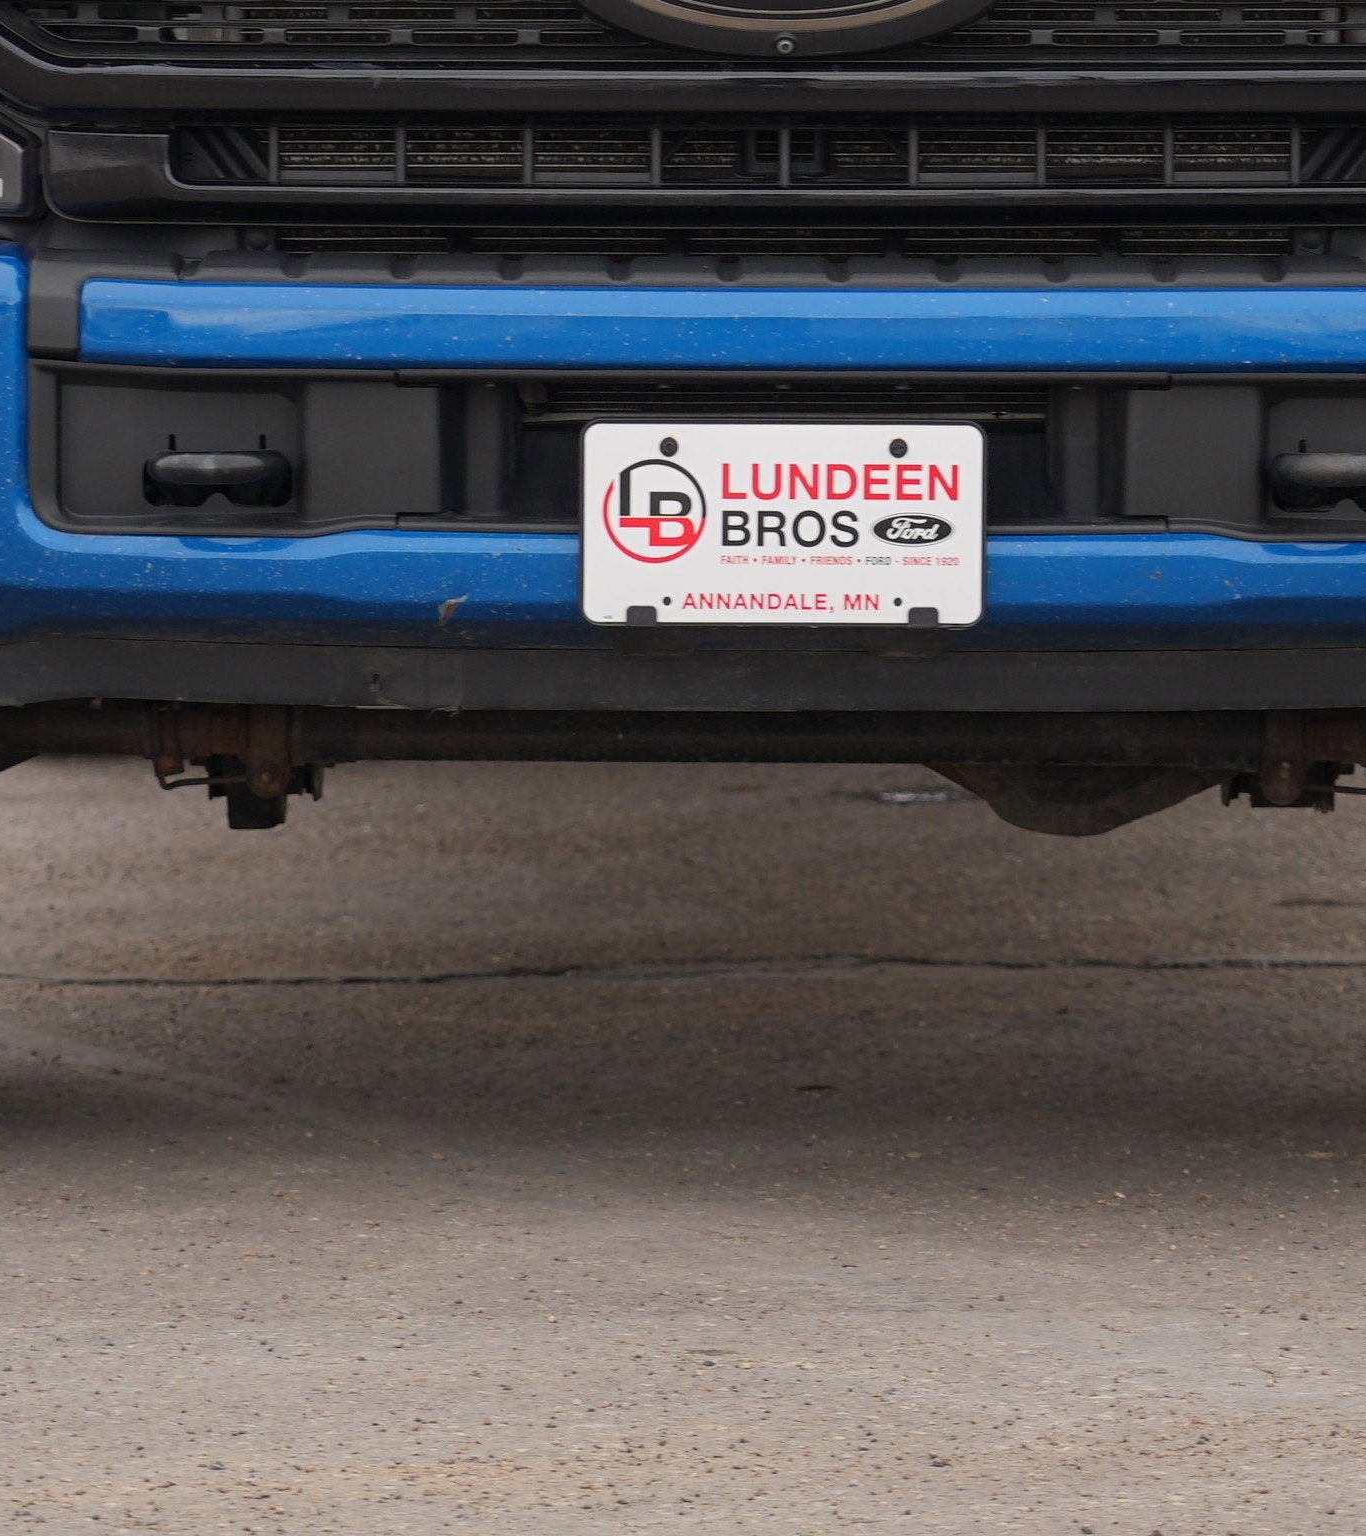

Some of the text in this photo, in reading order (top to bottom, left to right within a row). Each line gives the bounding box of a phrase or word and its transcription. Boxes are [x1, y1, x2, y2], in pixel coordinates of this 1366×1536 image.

[721, 463, 960, 501] LUNDEEN
[721, 510, 860, 547] BROS
[886, 517, 940, 540] Ford
[721, 555, 750, 565] FAITH
[762, 555, 797, 566] FAMILY
[810, 555, 853, 566] FRIENDS
[865, 556, 891, 566] FORD
[902, 556, 932, 566] SINCE
[683, 593, 880, 613] ANNANDALE, MN
